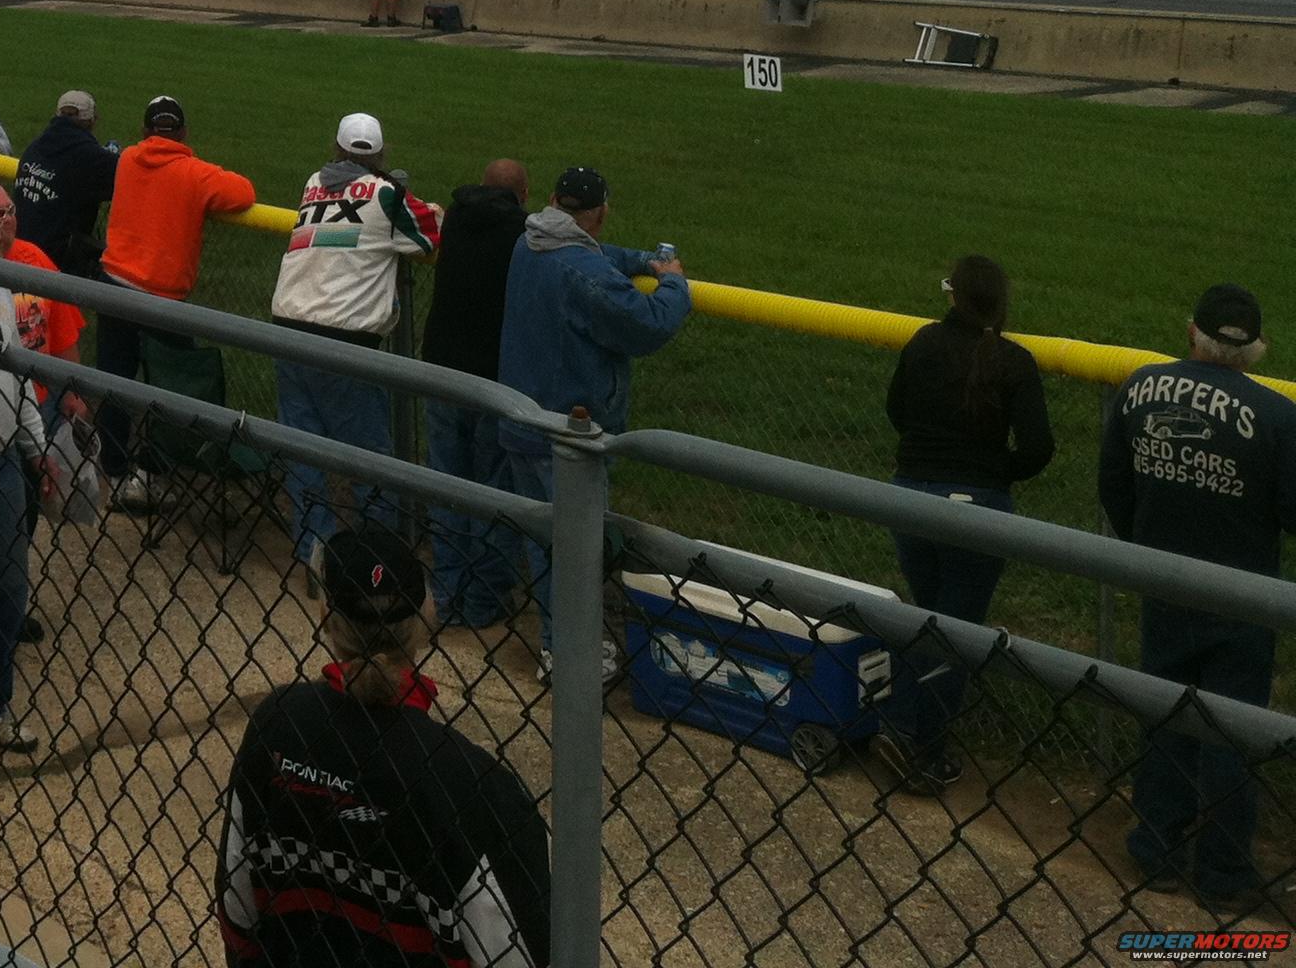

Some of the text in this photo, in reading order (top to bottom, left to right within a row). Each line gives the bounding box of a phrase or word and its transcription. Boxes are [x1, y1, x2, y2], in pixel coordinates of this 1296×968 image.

[747, 57, 778, 88] 150
[1122, 375, 1255, 439] HARPER'S
[1180, 446, 1237, 477] CARS
[281, 757, 354, 795] PONTIAC
